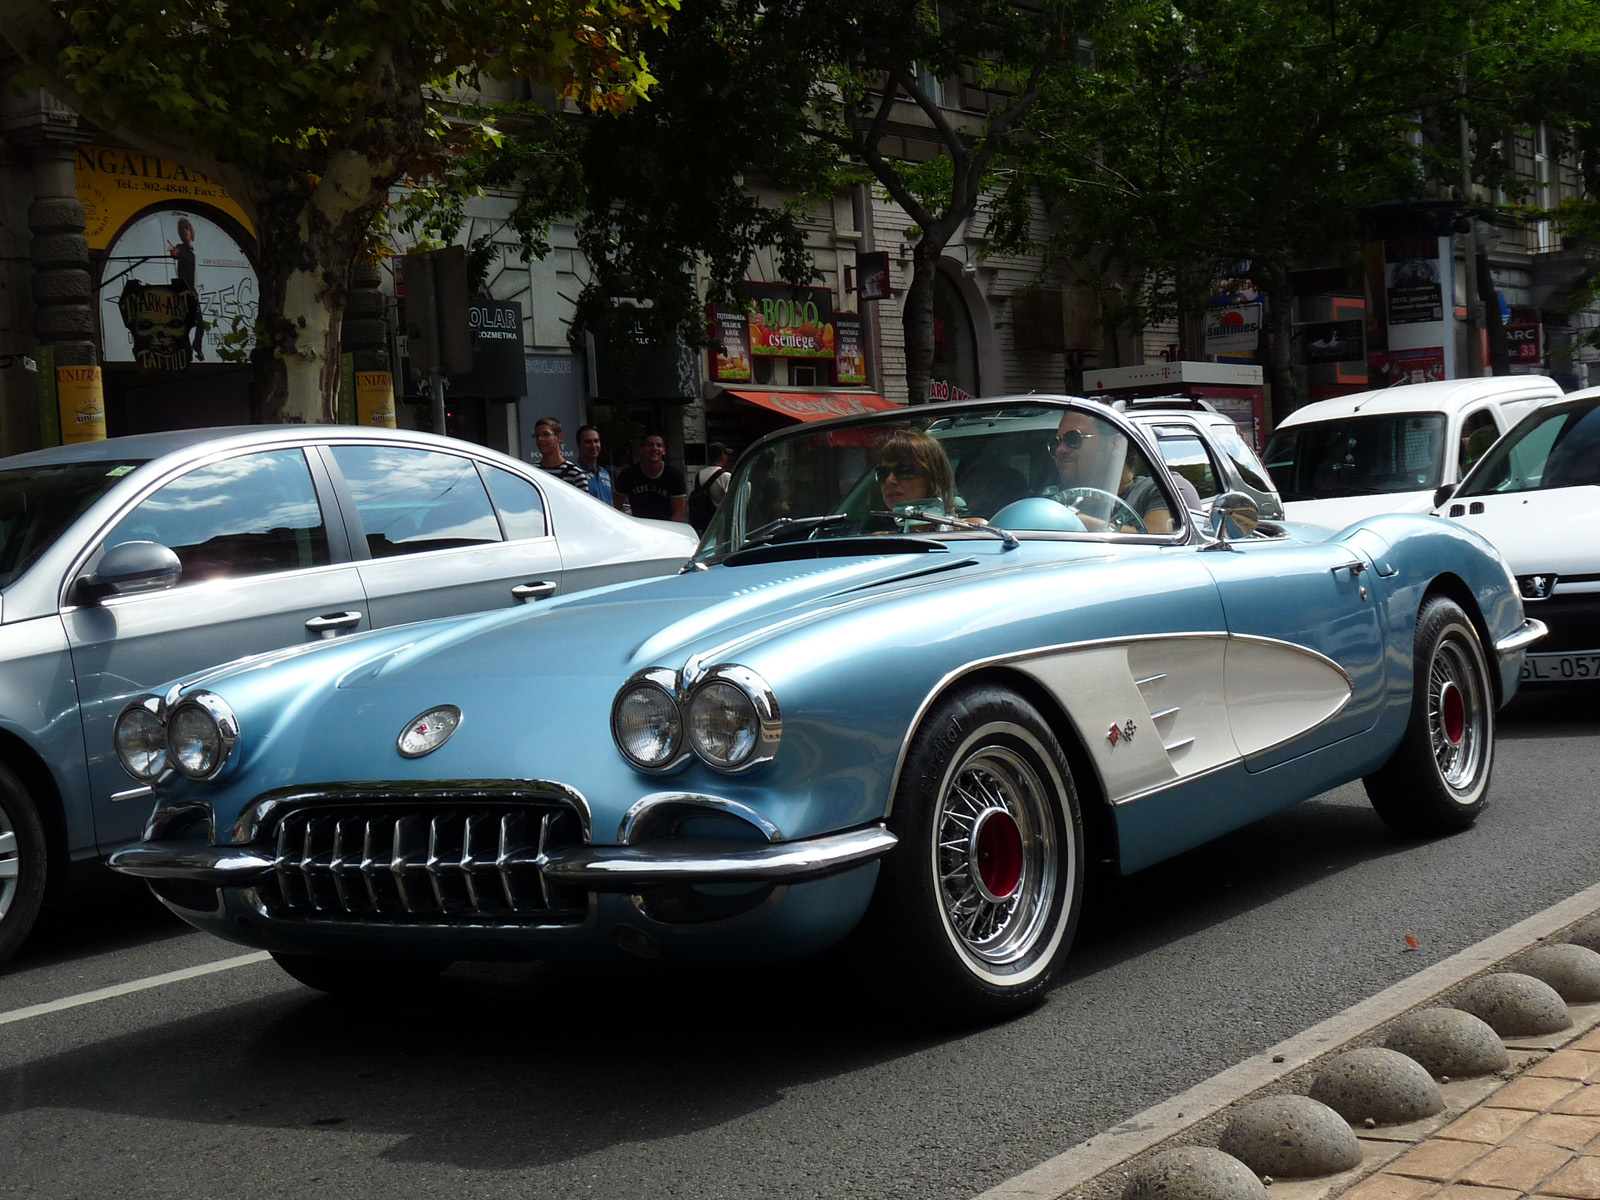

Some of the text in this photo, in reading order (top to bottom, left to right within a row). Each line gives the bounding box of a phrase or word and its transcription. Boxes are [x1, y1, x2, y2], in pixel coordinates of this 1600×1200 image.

[115, 178, 138, 190] Tel.:
[194, 187, 217, 198] Fax:
[761, 292, 819, 329] BODÓ
[478, 331, 517, 340] OZMETIKA
[769, 334, 815, 351] csemege
[1521, 344, 1536, 357] 33
[137, 349, 188, 371] TATTOO
